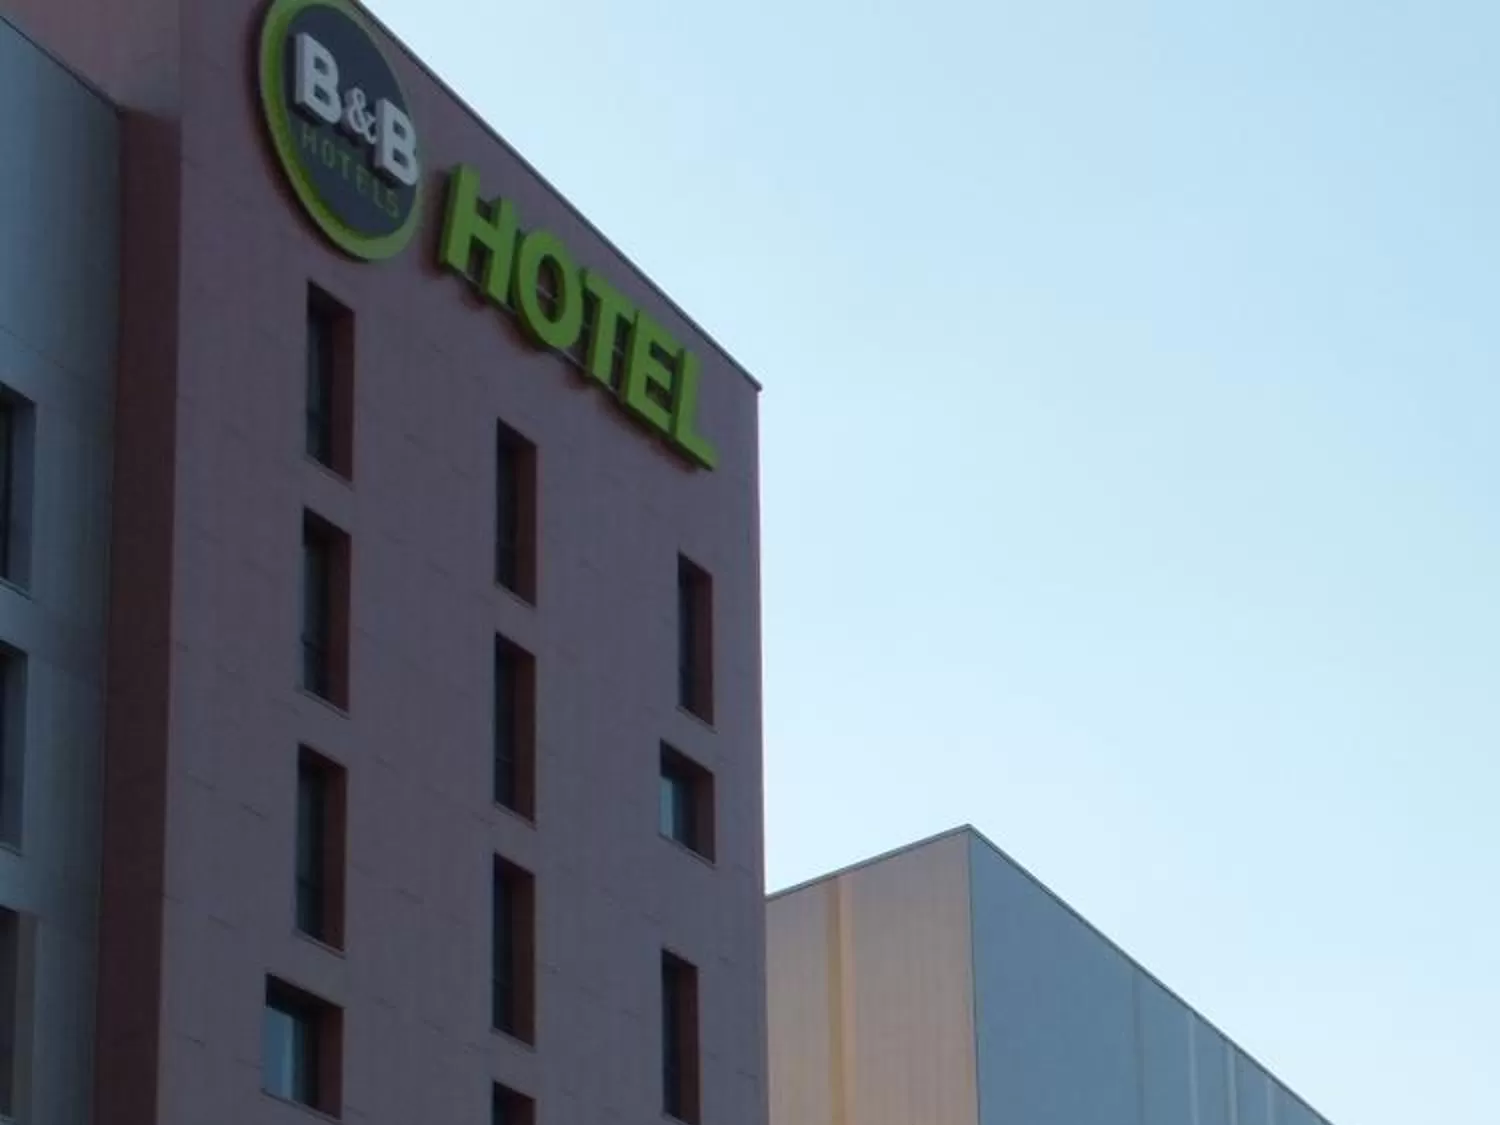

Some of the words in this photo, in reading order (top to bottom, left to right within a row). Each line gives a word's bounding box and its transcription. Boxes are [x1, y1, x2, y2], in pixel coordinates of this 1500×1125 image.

[295, 32, 419, 186] B&B
[302, 123, 399, 218] HOTELS
[440, 163, 717, 471] HOTEL
